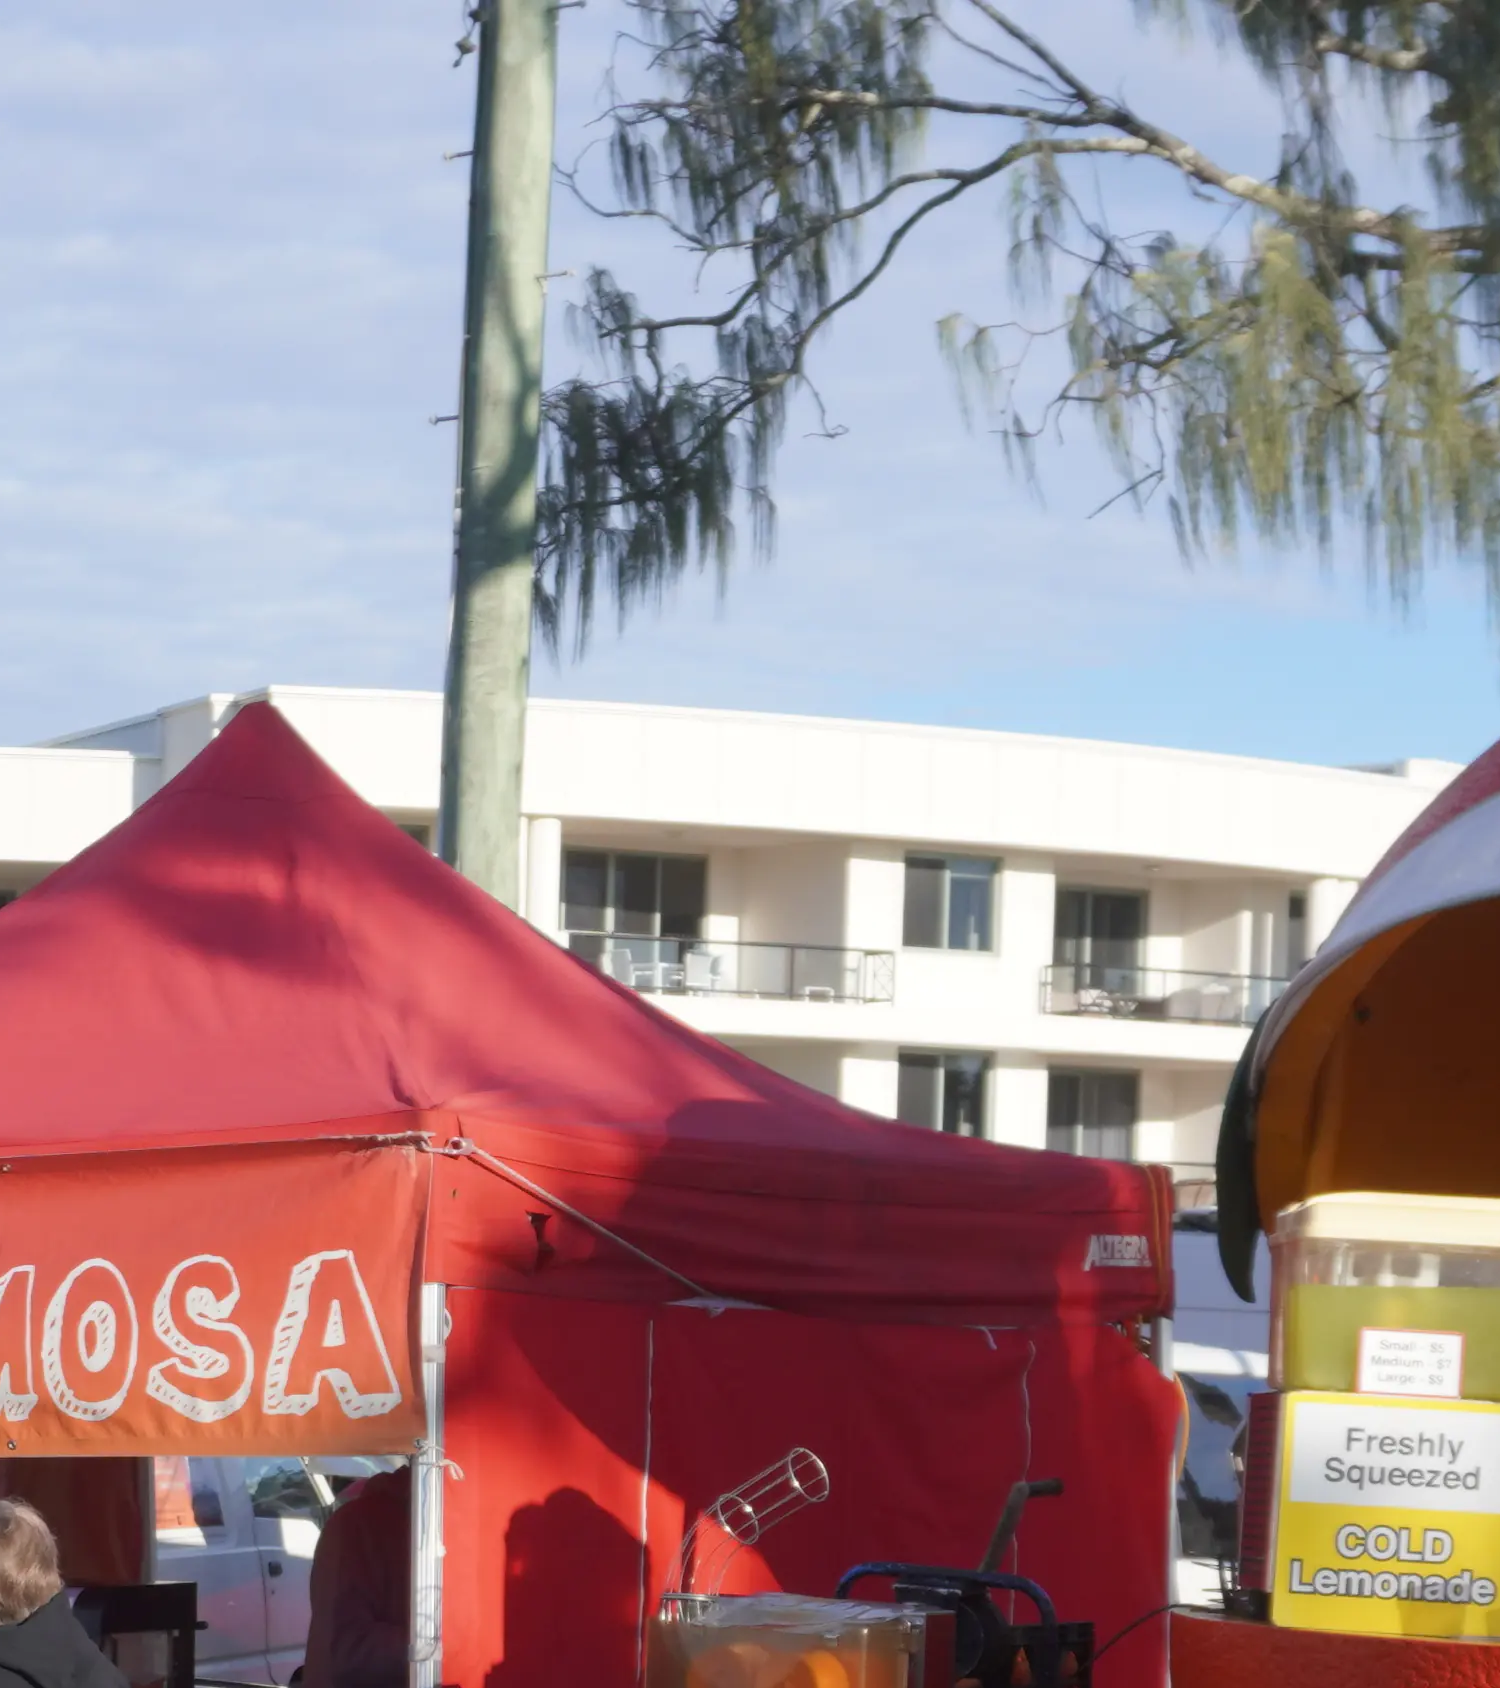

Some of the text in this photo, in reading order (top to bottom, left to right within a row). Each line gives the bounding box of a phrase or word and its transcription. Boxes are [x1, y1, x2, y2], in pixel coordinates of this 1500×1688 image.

[1370, 1354, 1425, 1368] Medium
[1379, 1339, 1417, 1352] Small
[1377, 1373, 1417, 1386] Large
[1346, 1427, 1465, 1465] Freshly
[1323, 1456, 1482, 1491] Squeezed
[1335, 1523, 1455, 1564] COLD
[1289, 1558, 1498, 1607] Lemonade
